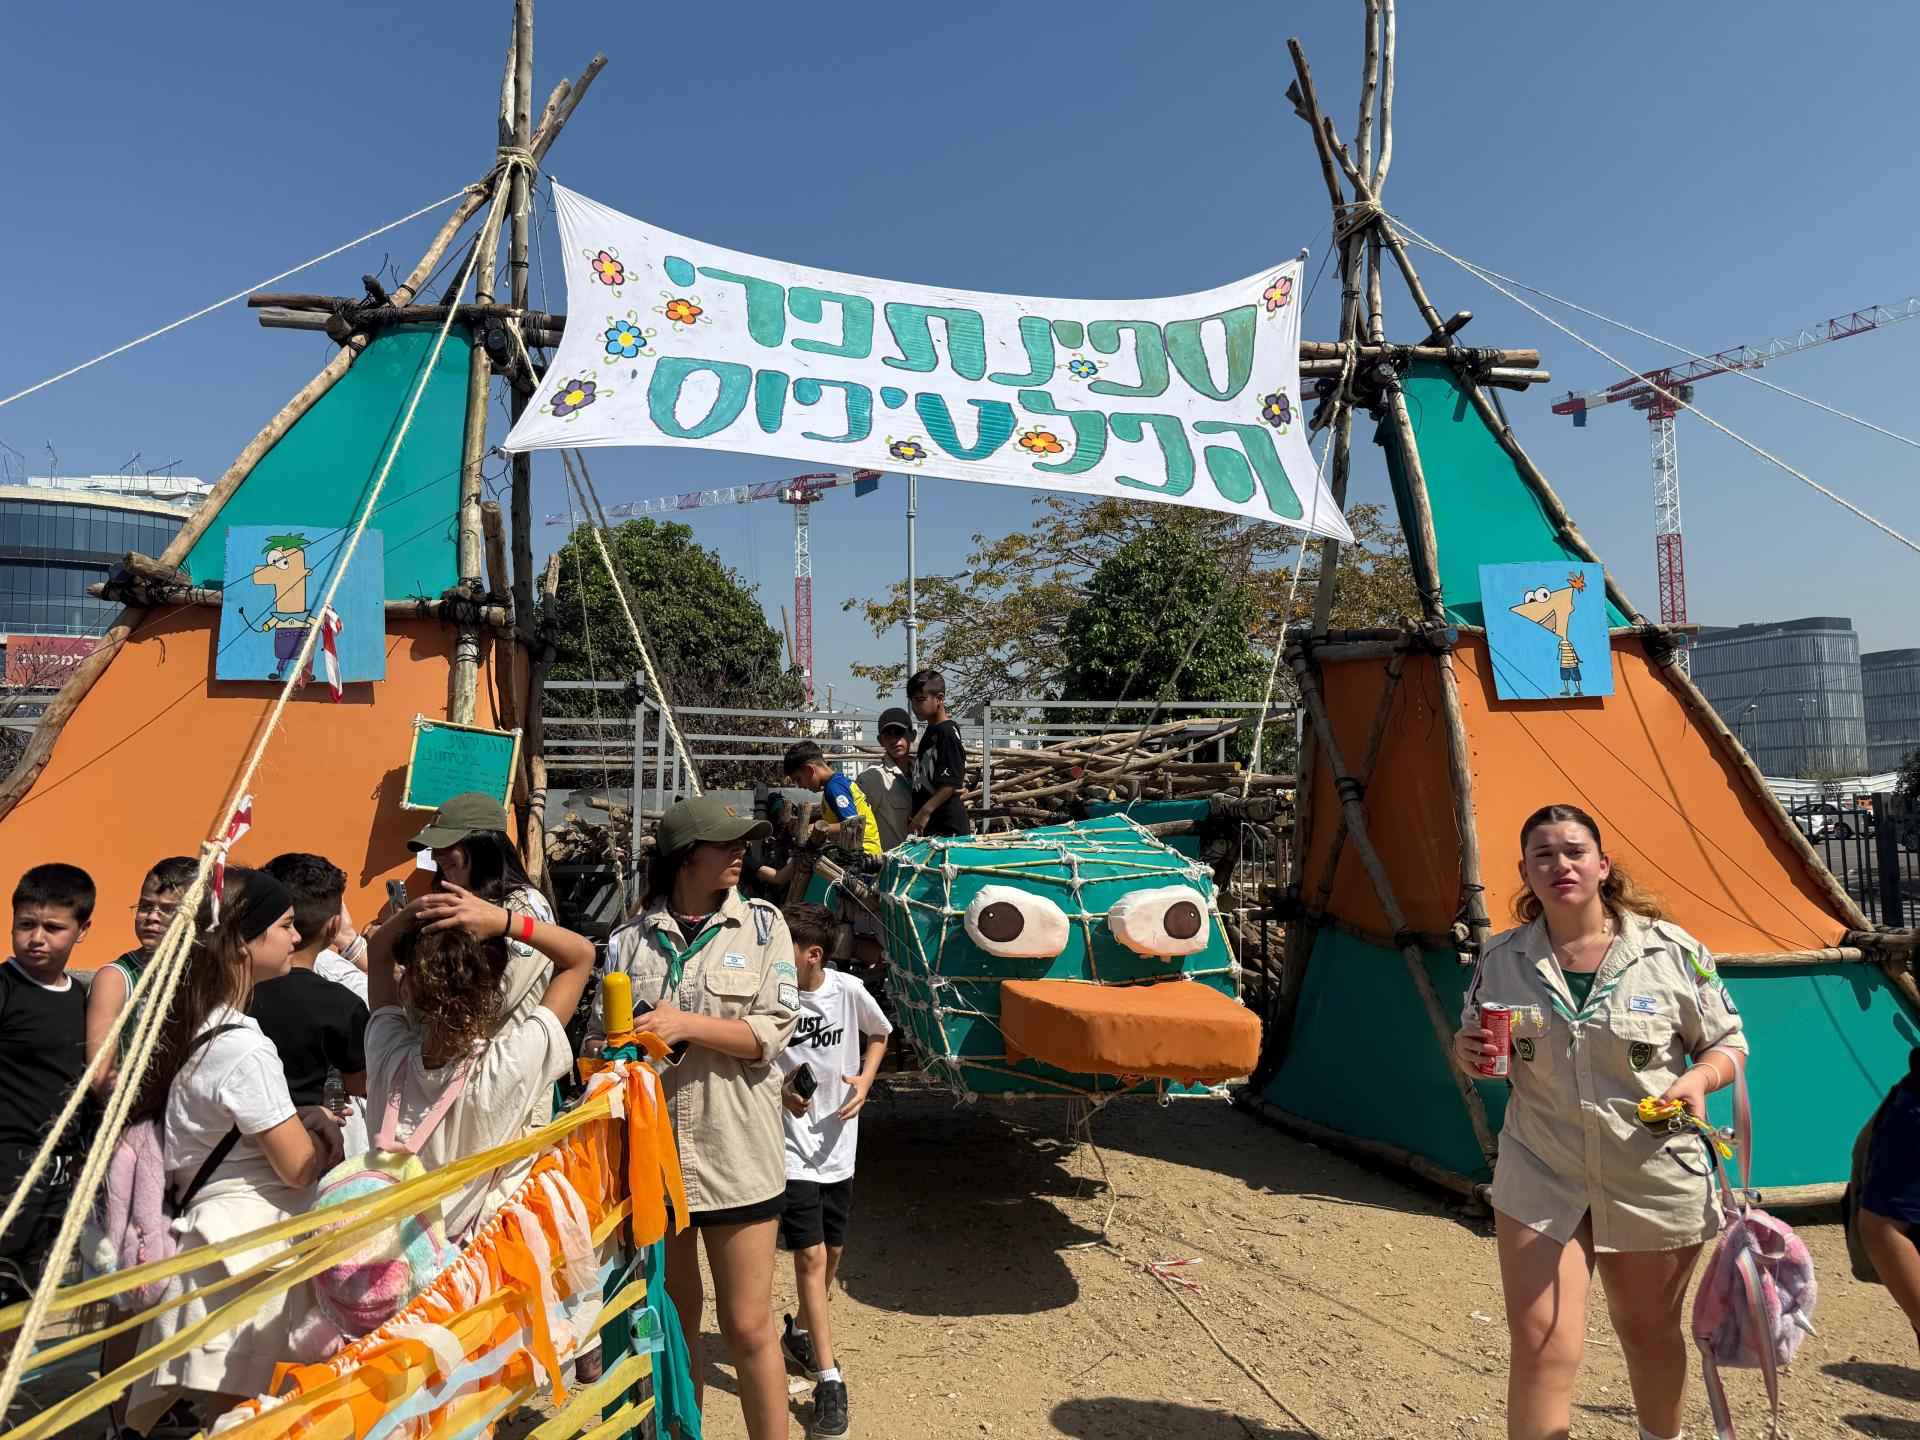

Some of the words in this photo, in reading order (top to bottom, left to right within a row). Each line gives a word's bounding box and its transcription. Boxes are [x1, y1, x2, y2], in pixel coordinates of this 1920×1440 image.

[663, 255, 875, 360] פרי
[882, 302, 1257, 402] ספינת
[647, 355, 1304, 520] הפלטיפוס
[794, 1016, 823, 1034] UST
